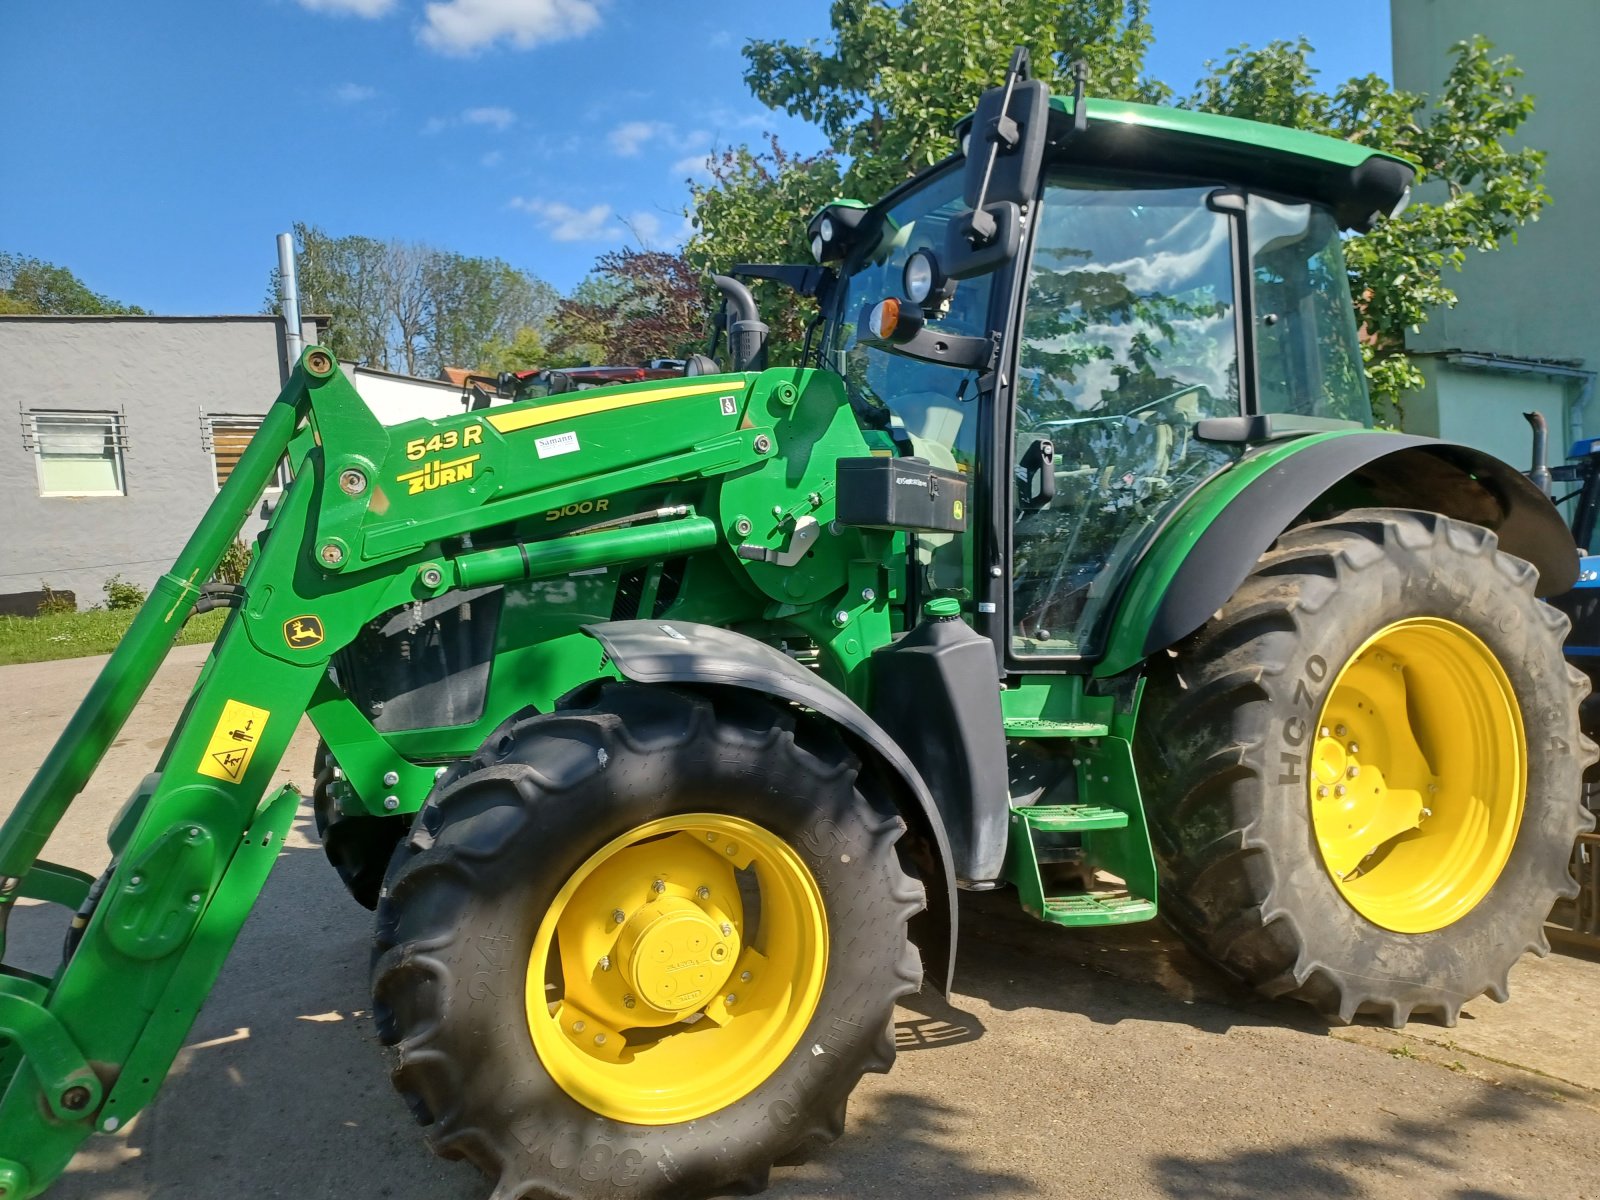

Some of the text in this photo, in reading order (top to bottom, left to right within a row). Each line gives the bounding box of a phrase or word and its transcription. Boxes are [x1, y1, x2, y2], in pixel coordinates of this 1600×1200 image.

[406, 424, 484, 461] 543 R
[595, 499, 609, 512] R
